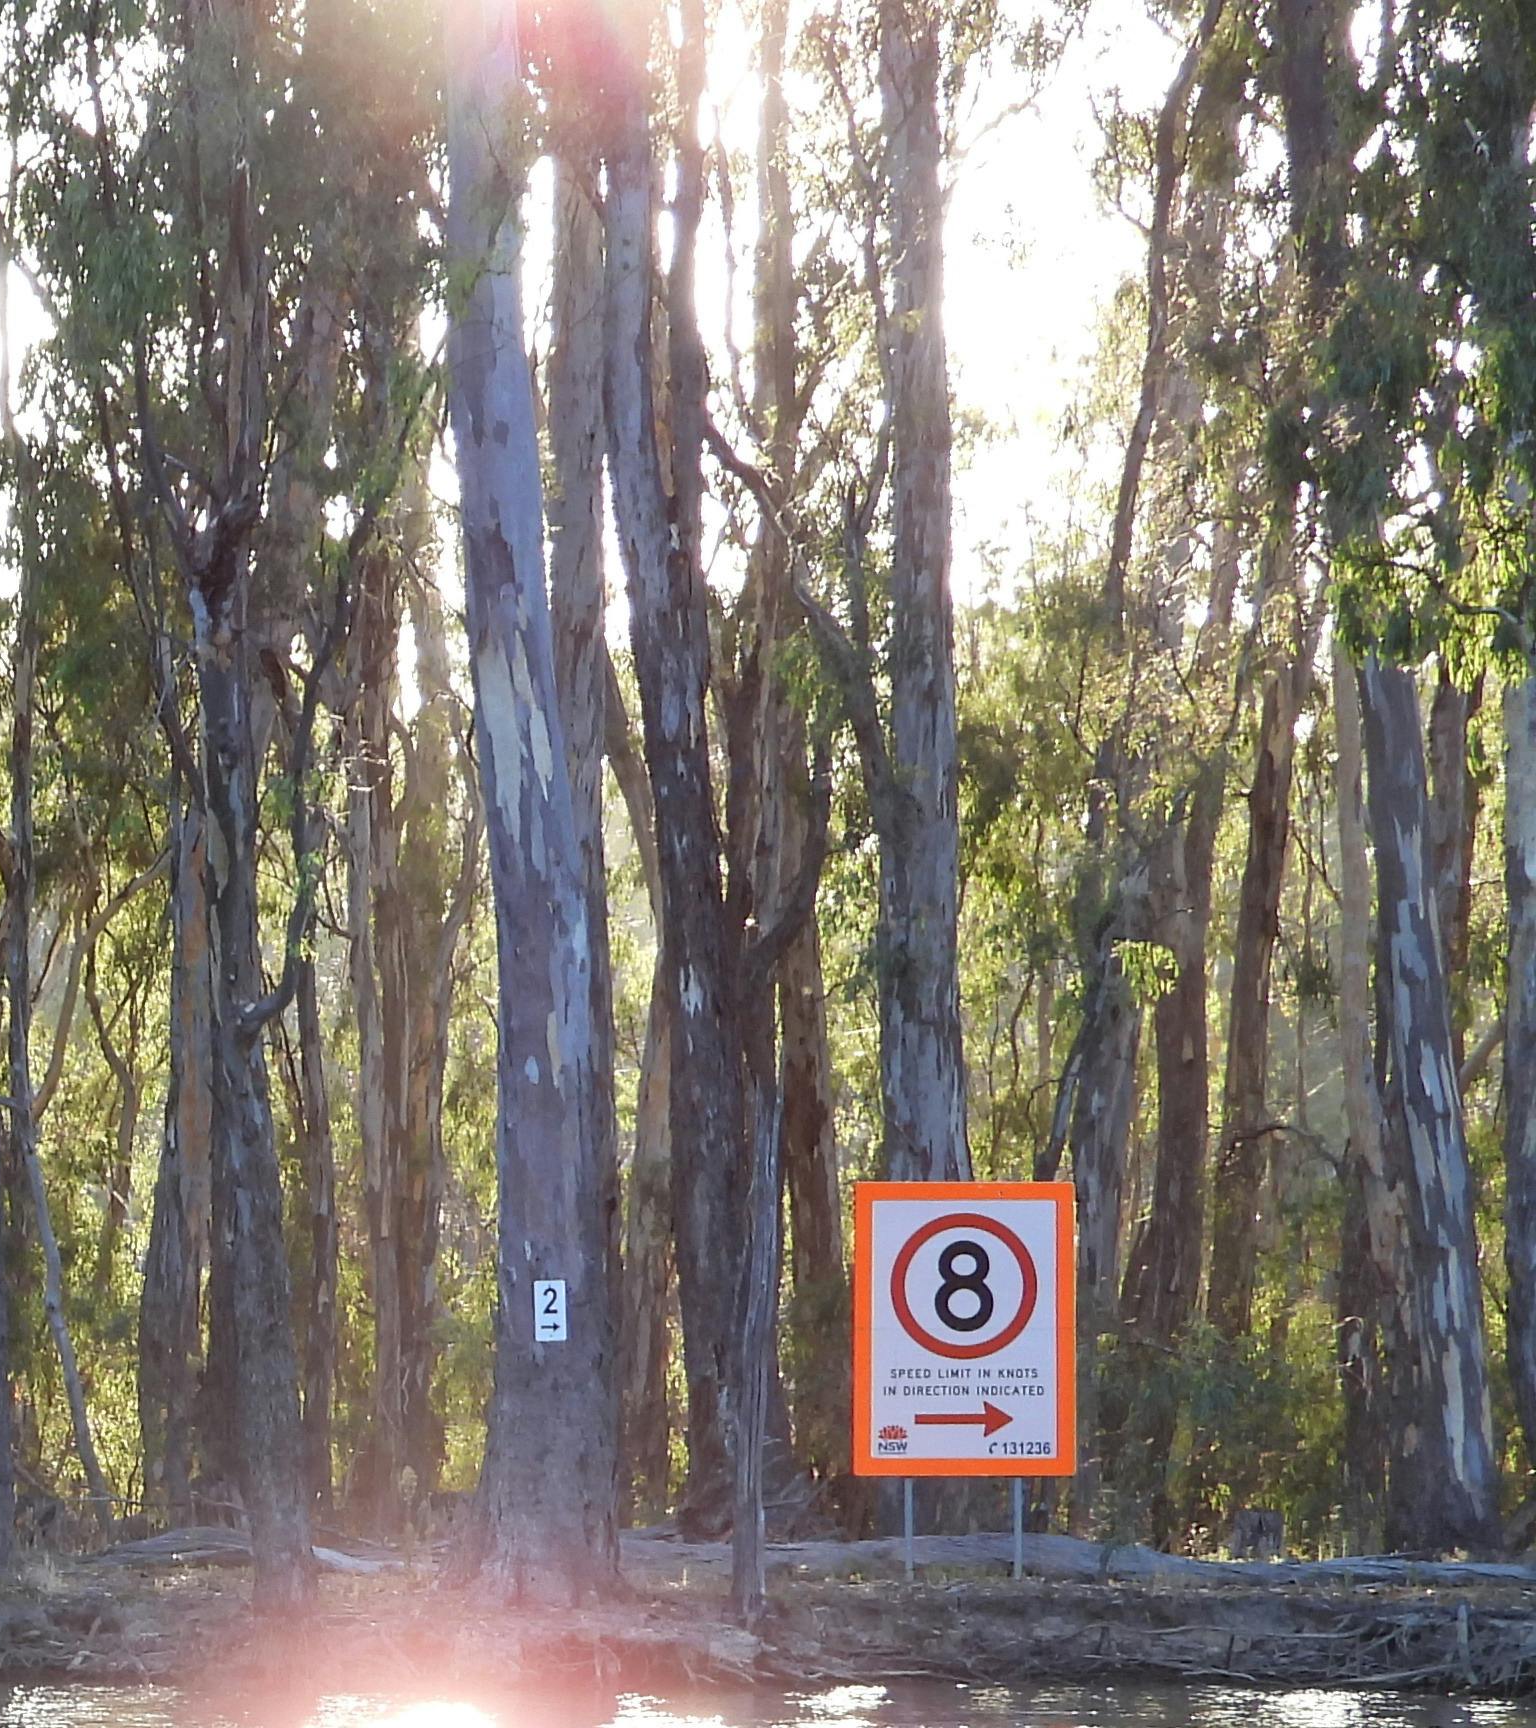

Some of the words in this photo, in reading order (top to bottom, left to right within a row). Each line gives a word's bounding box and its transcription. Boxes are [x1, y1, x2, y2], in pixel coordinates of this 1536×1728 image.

[934, 1240, 994, 1332] 8
[543, 1287, 558, 1314] 2
[890, 1368, 931, 1379] SPEED
[938, 1368, 971, 1379] LIMIT
[978, 1368, 991, 1379] IN
[998, 1368, 1038, 1379] KNOTS
[883, 1385, 896, 1396] IN
[903, 1385, 970, 1396] DIRECTION
[977, 1385, 1045, 1396] INDICATED
[878, 1441, 908, 1451] NSW
[1002, 1442, 1051, 1455] 131236
